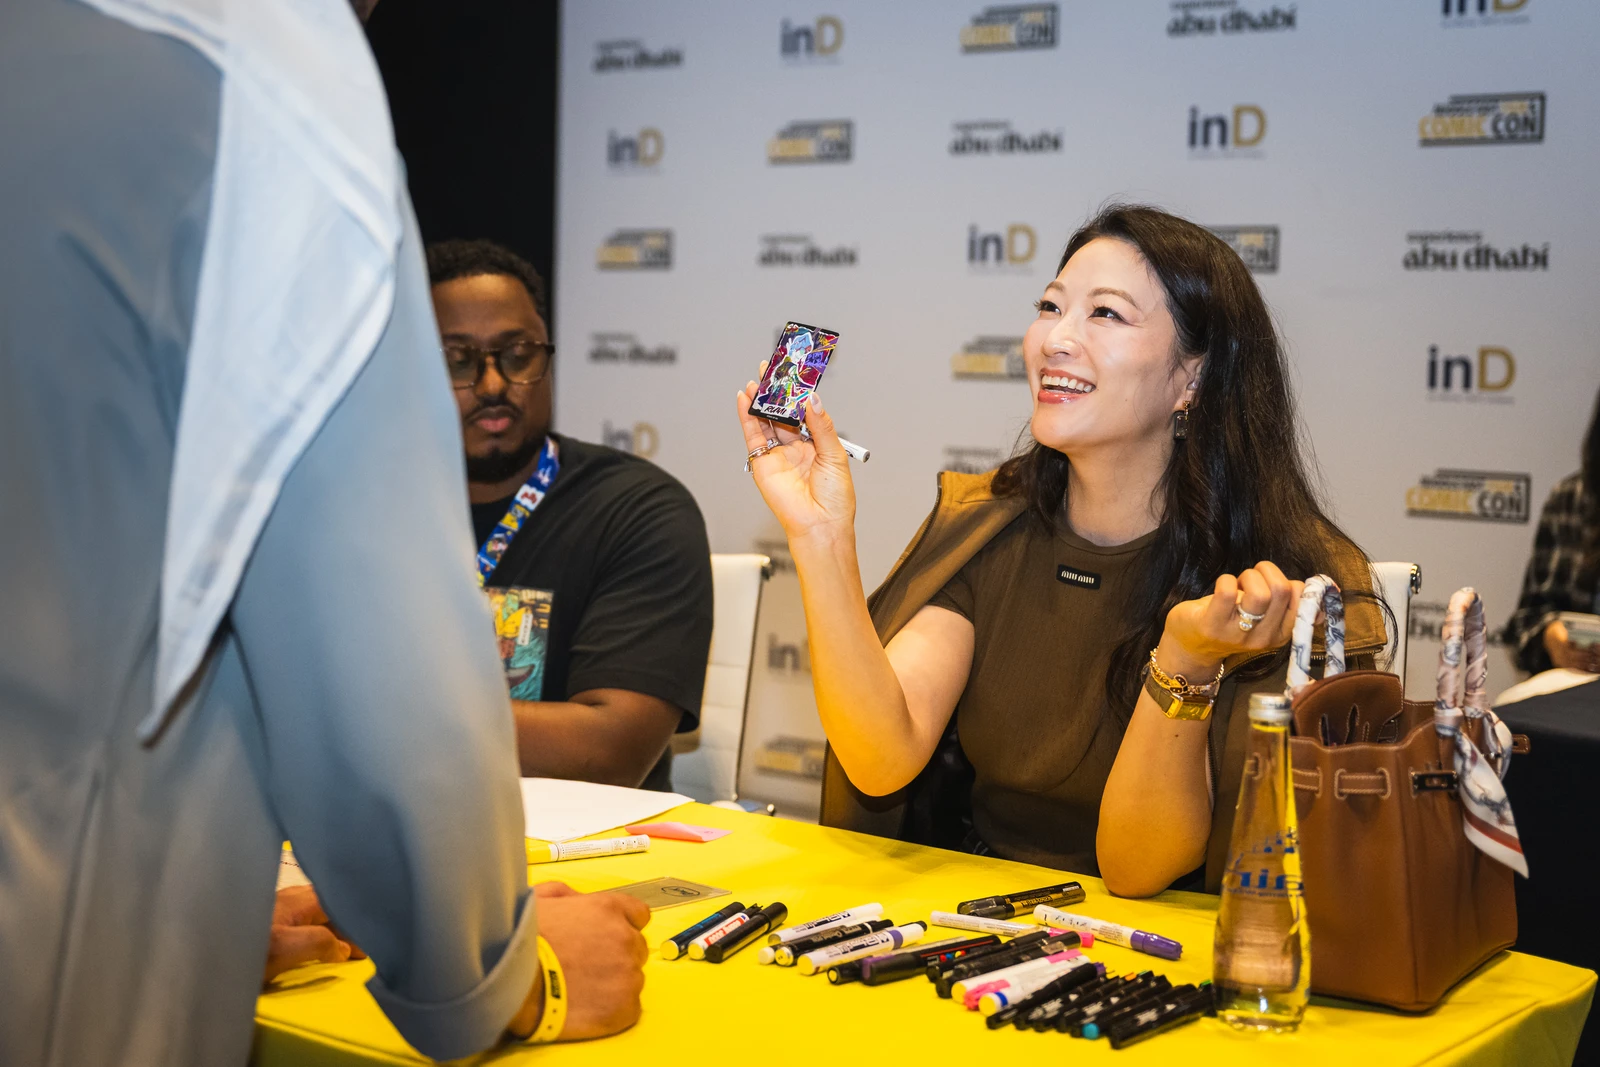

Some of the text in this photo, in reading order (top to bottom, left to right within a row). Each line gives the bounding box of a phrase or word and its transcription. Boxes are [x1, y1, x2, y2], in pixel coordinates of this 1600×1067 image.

[779, 16, 844, 57] inD
[1187, 104, 1267, 148] inD
[1491, 112, 1537, 138] CON
[967, 223, 1038, 265] inD
[1402, 243, 1550, 271] abu dhabi
[1427, 344, 1516, 392] inD
[1061, 570, 1095, 584] miu miu
